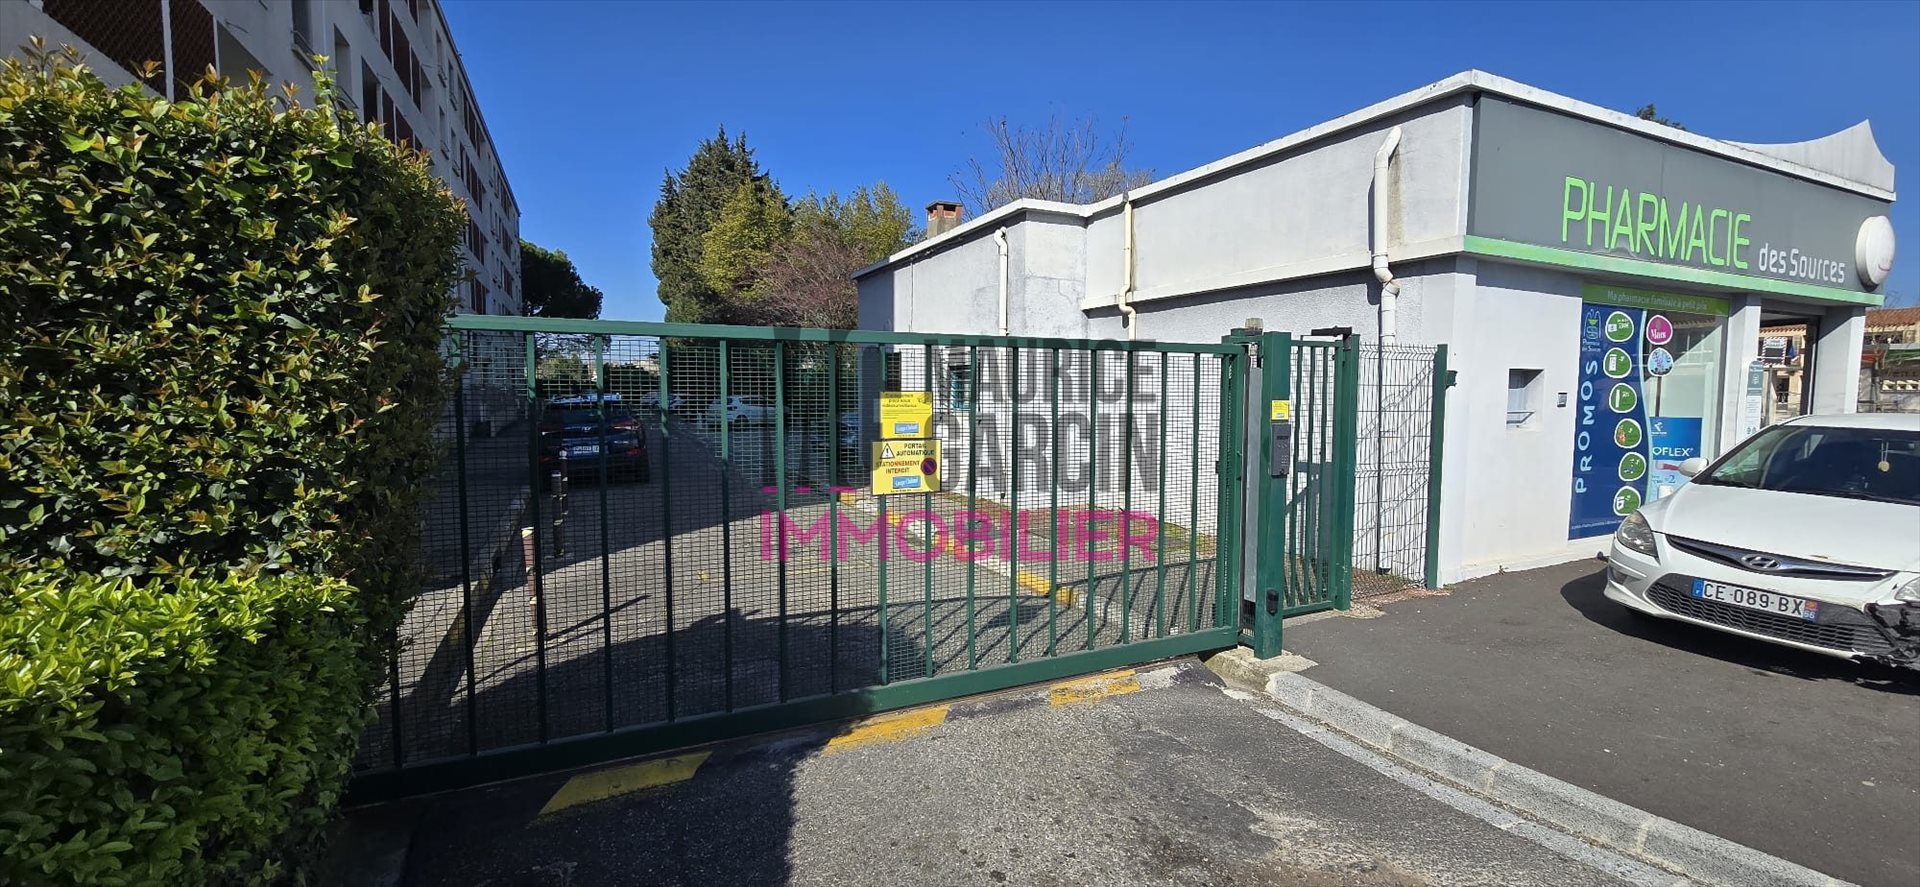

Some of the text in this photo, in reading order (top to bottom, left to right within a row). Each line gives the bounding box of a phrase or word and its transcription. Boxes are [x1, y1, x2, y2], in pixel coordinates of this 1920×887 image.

[1561, 176, 1845, 284] PHARMACIE des Sources
[1574, 360, 1599, 494] PROMOS
